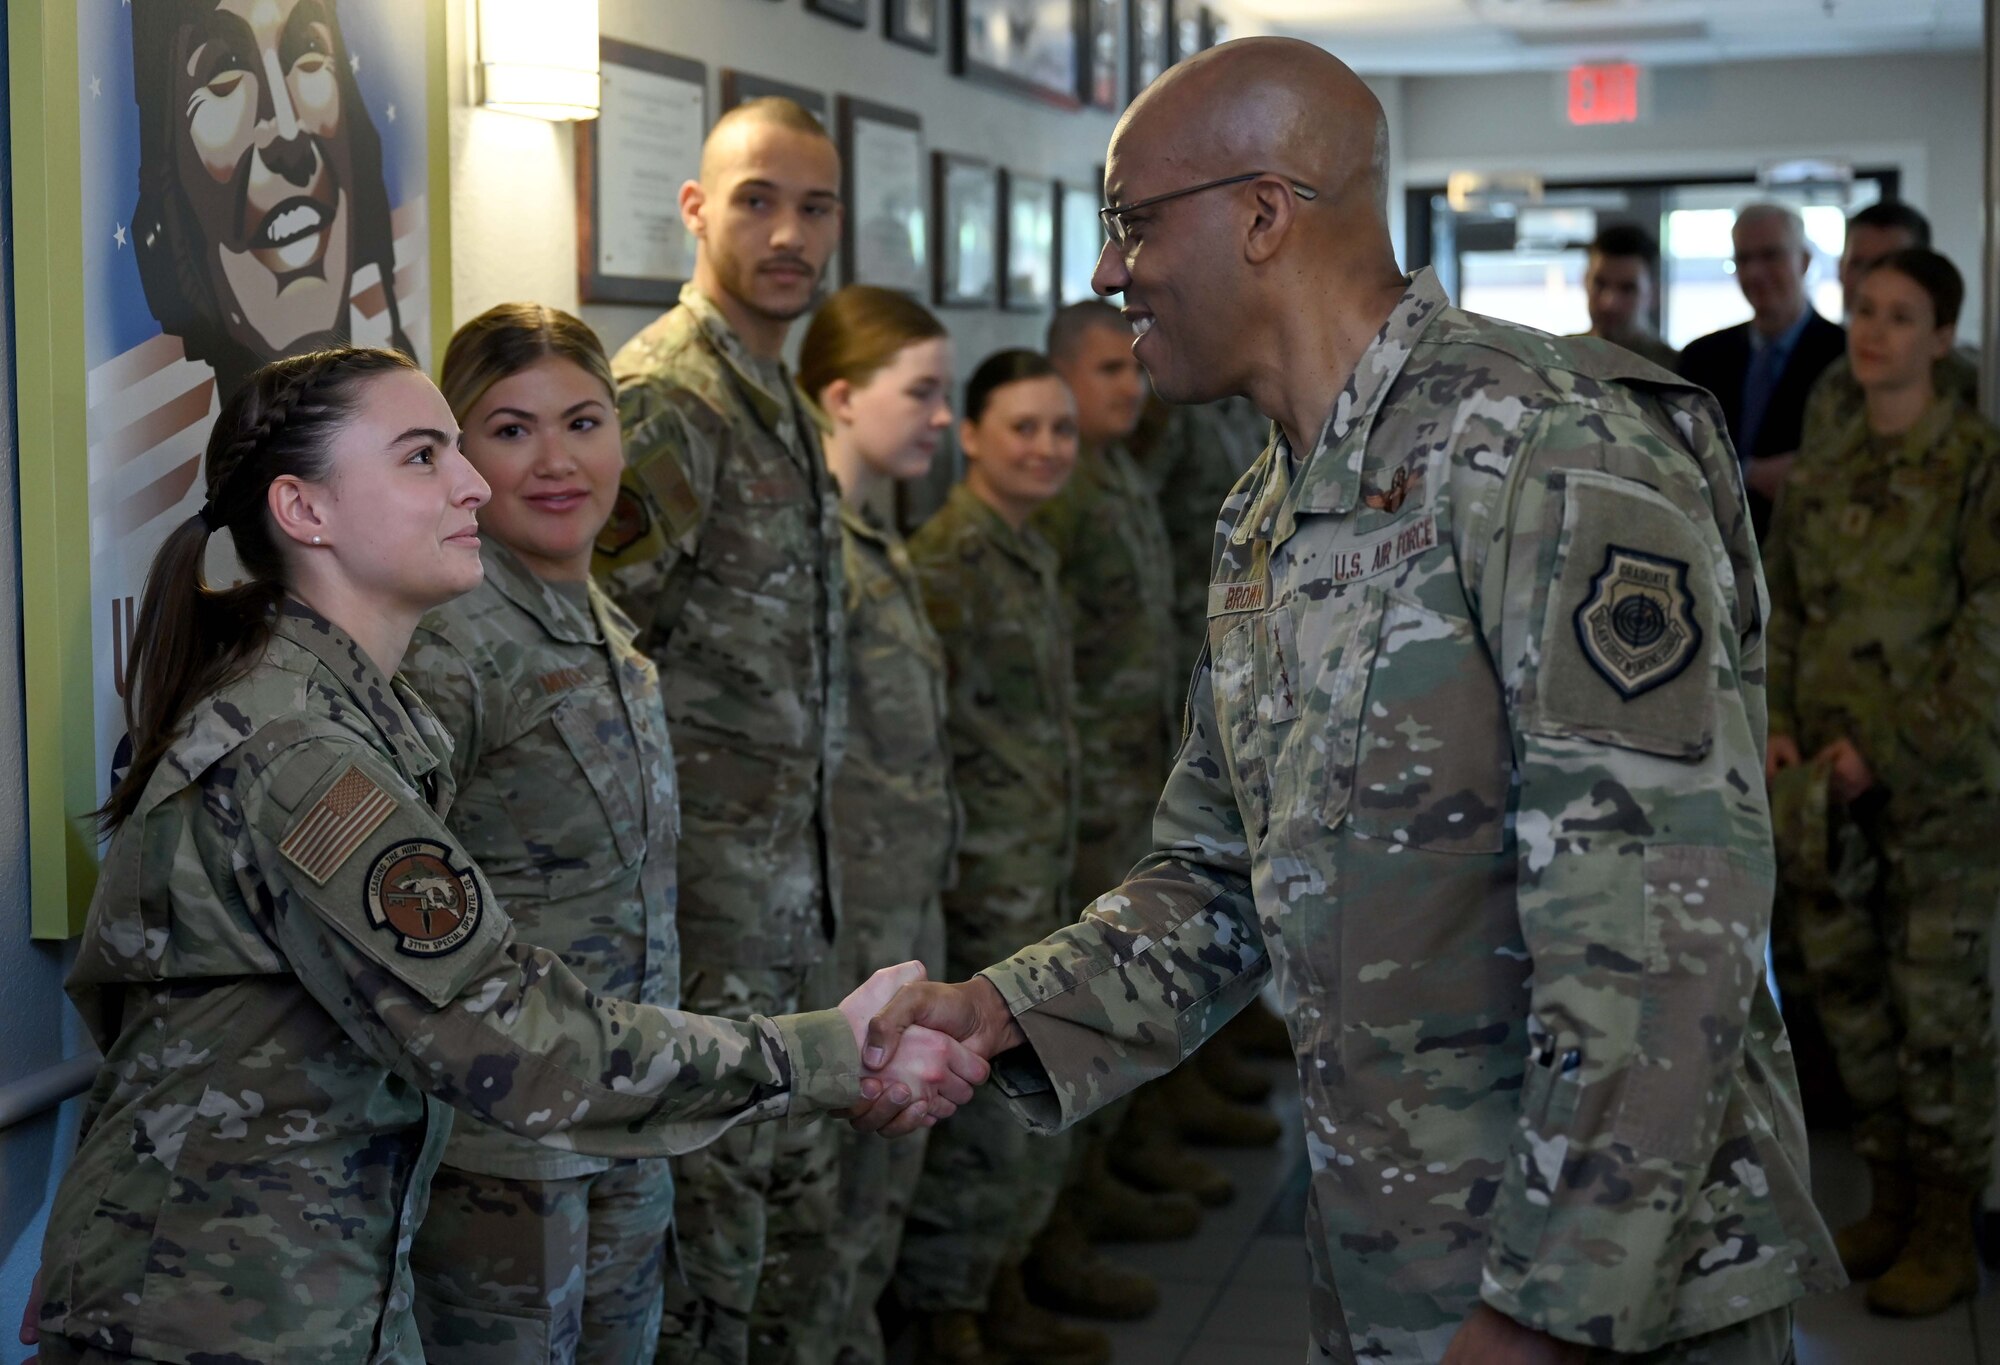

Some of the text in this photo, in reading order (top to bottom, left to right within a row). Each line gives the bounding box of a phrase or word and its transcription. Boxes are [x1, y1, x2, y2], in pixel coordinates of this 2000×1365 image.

[1334, 517, 1434, 581] U.S. AIR FORCE
[1619, 561, 1670, 588] GRADUATE
[1224, 583, 1264, 610] BROWN
[370, 844, 422, 897] LEADING THE HUNT
[463, 879, 473, 890] SQ
[467, 893, 477, 915] INTEL
[461, 917, 474, 931] OPS
[433, 931, 464, 950] SPECIAL
